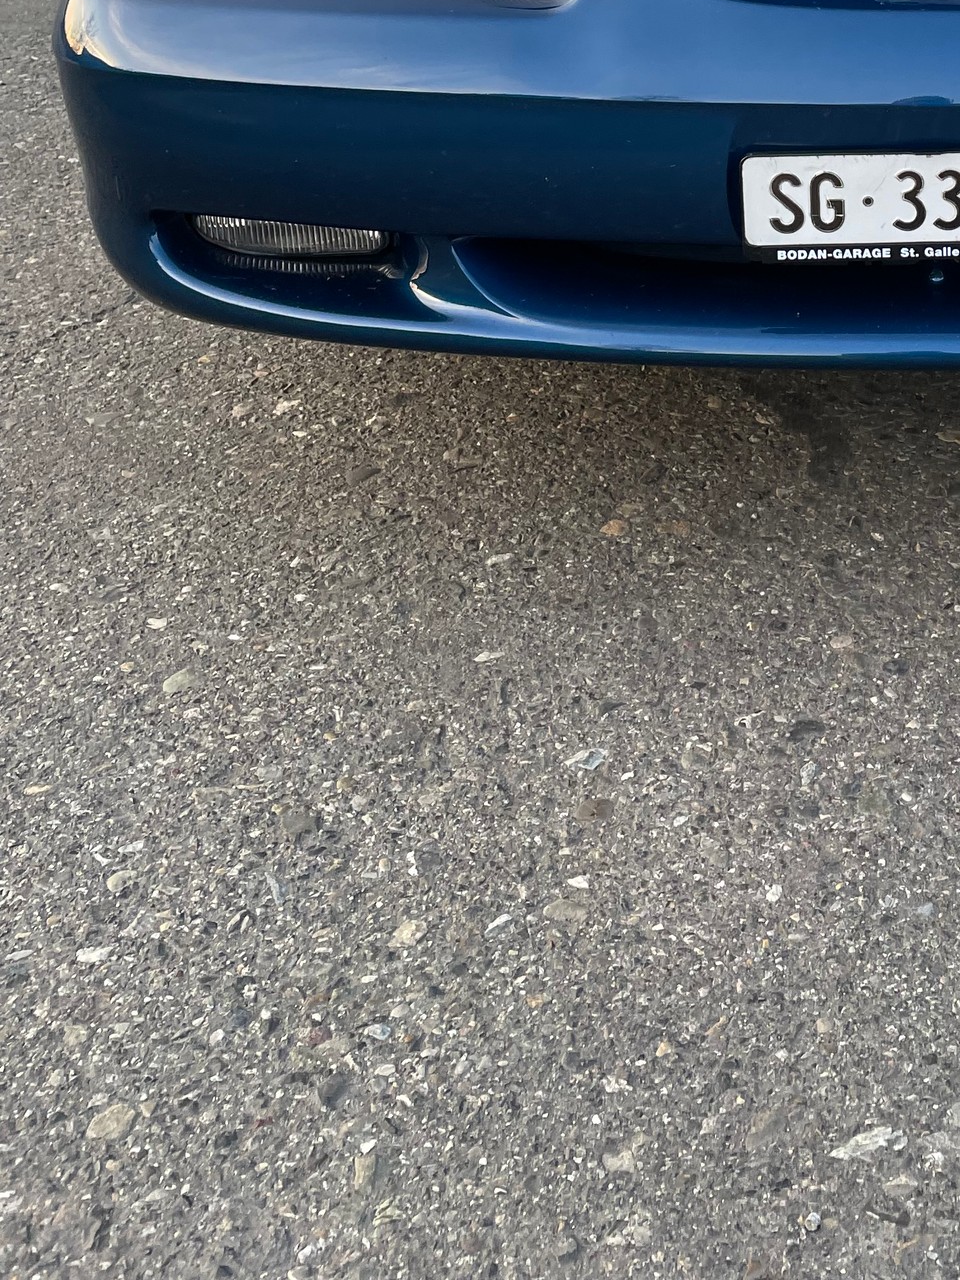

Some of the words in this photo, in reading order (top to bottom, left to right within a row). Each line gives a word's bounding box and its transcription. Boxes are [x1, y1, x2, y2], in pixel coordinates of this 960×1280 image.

[769, 172, 846, 234] SG
[777, 247, 892, 261] BODAN-GARAGE
[900, 246, 920, 258] St.
